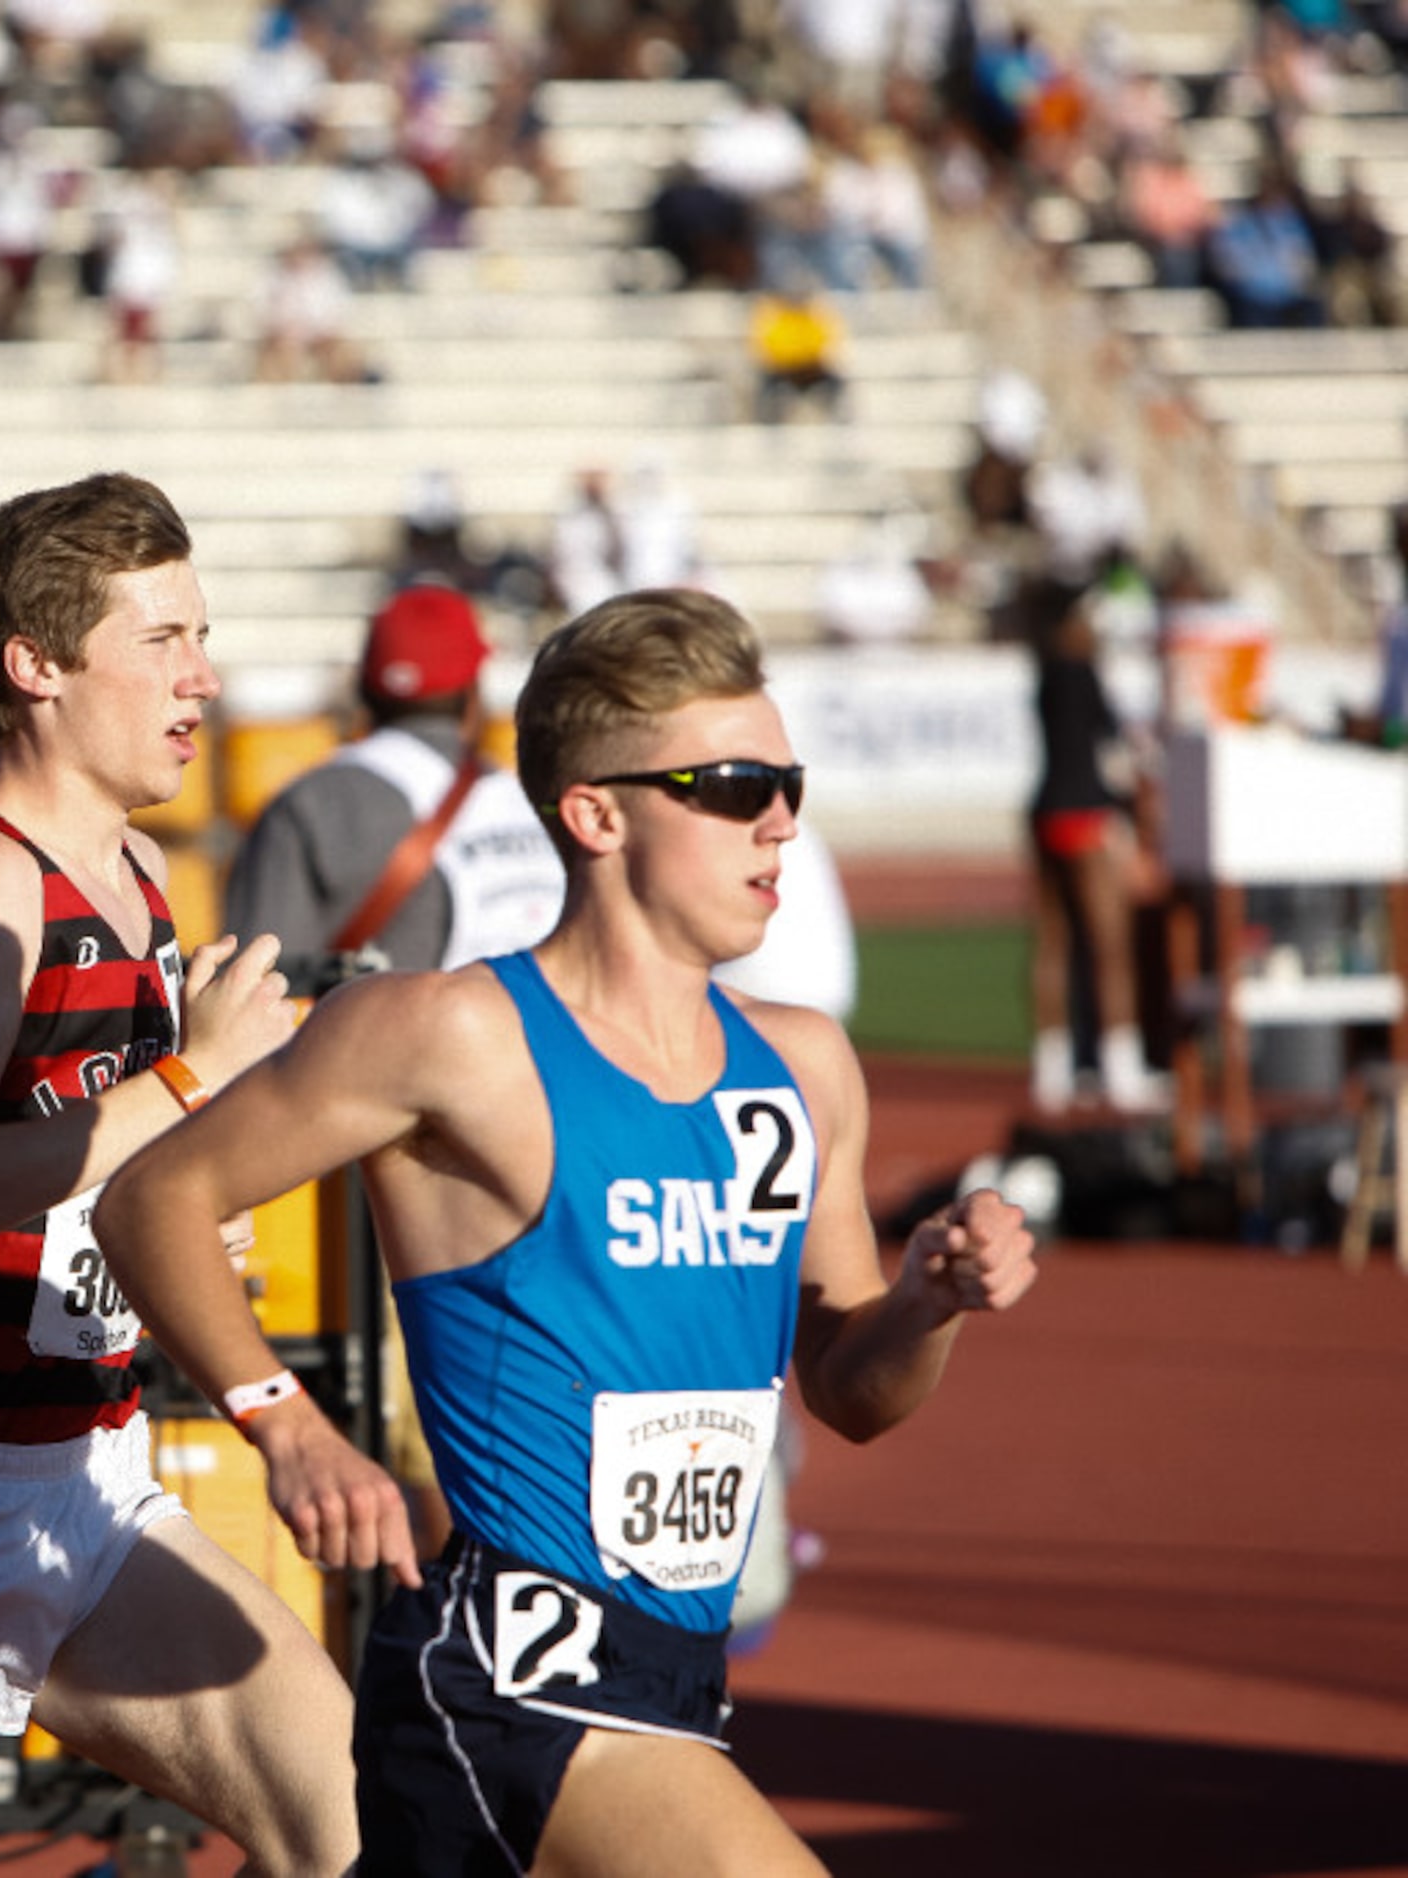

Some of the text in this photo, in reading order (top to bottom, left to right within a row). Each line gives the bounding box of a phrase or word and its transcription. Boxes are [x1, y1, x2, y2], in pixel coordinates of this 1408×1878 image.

[737, 1100, 800, 1212] 2
[606, 1178, 790, 1267] SAHS
[628, 1408, 757, 1446] TEXAS RELAYS
[622, 1465, 743, 1546] 3459
[512, 1584, 580, 1690] 2
